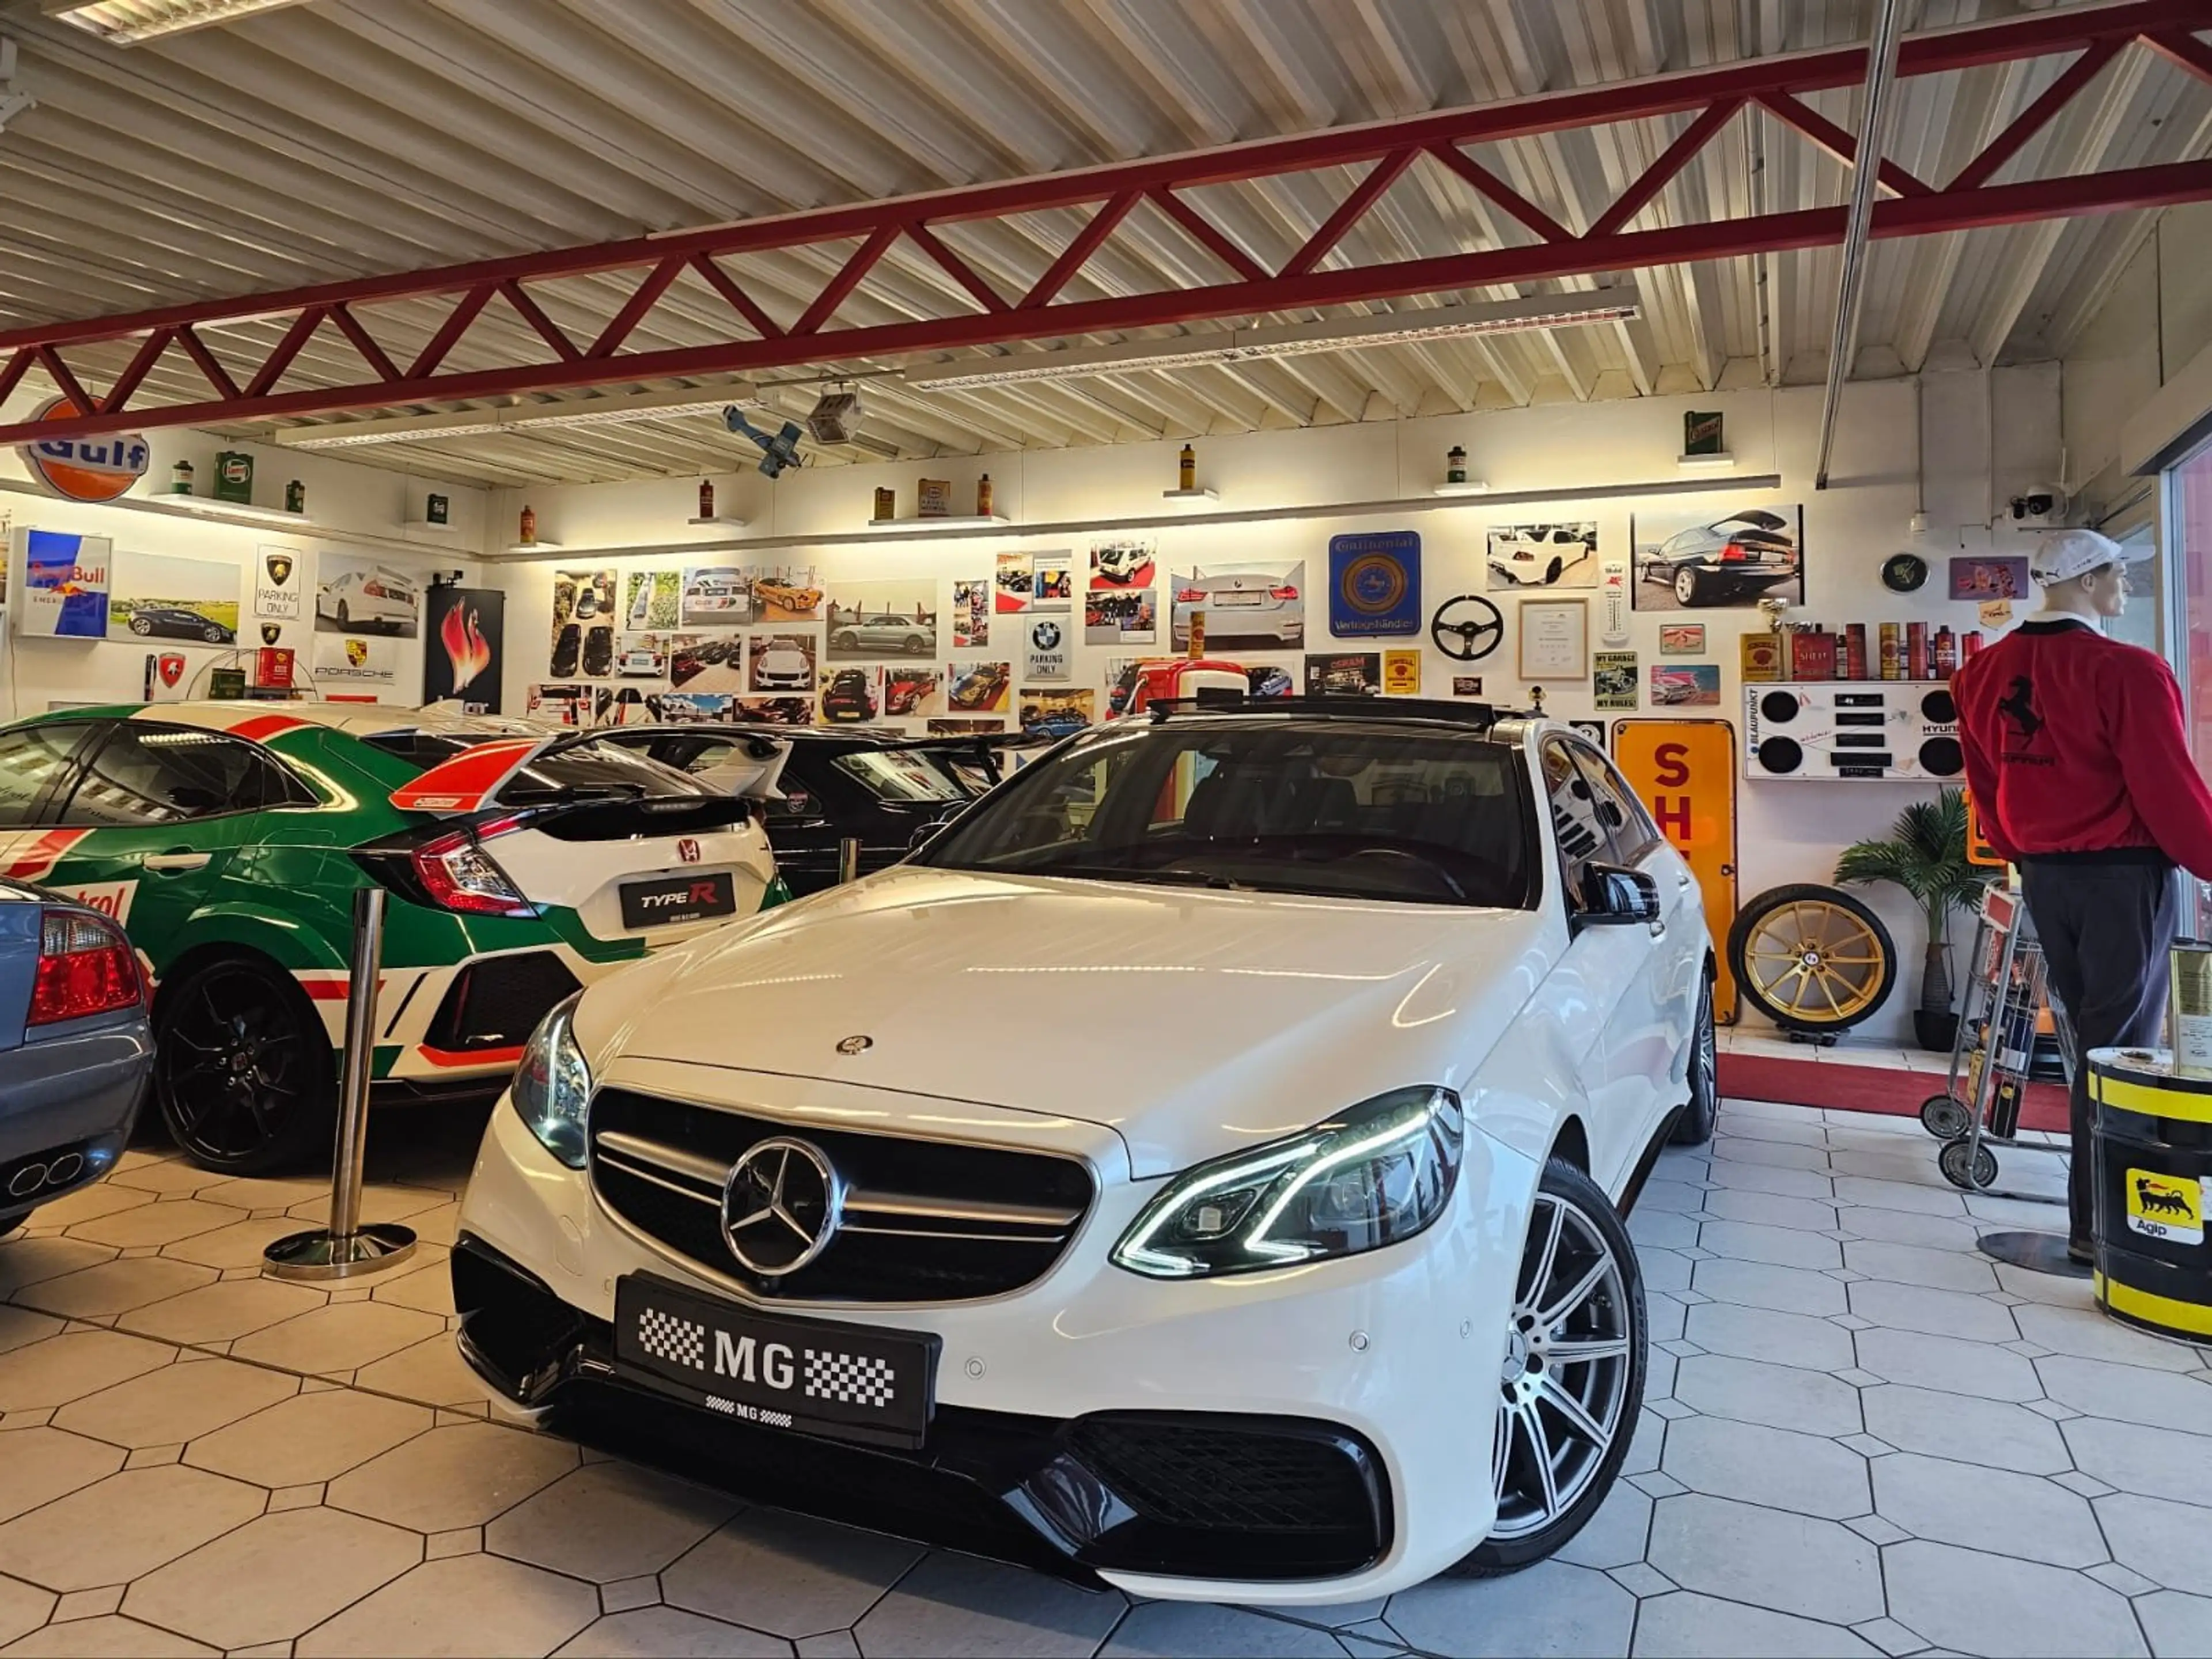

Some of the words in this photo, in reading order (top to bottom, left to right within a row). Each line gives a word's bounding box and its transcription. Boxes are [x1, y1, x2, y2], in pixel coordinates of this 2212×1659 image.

[39, 440, 145, 468] Gulf
[71, 566, 105, 584] Bull
[258, 588, 297, 603] PARKING
[267, 602, 289, 613] ONLY
[1030, 654, 1063, 664] PARKING
[315, 667, 394, 679] PORSCHE
[1037, 665, 1055, 675] ONLY
[1749, 688, 1759, 744] BLAUPUNKT
[641, 892, 688, 908] TYPE
[690, 882, 718, 903] R
[2136, 1219, 2167, 1236] Agip
[714, 1330, 794, 1389] MG
[737, 1404, 757, 1420] MG
